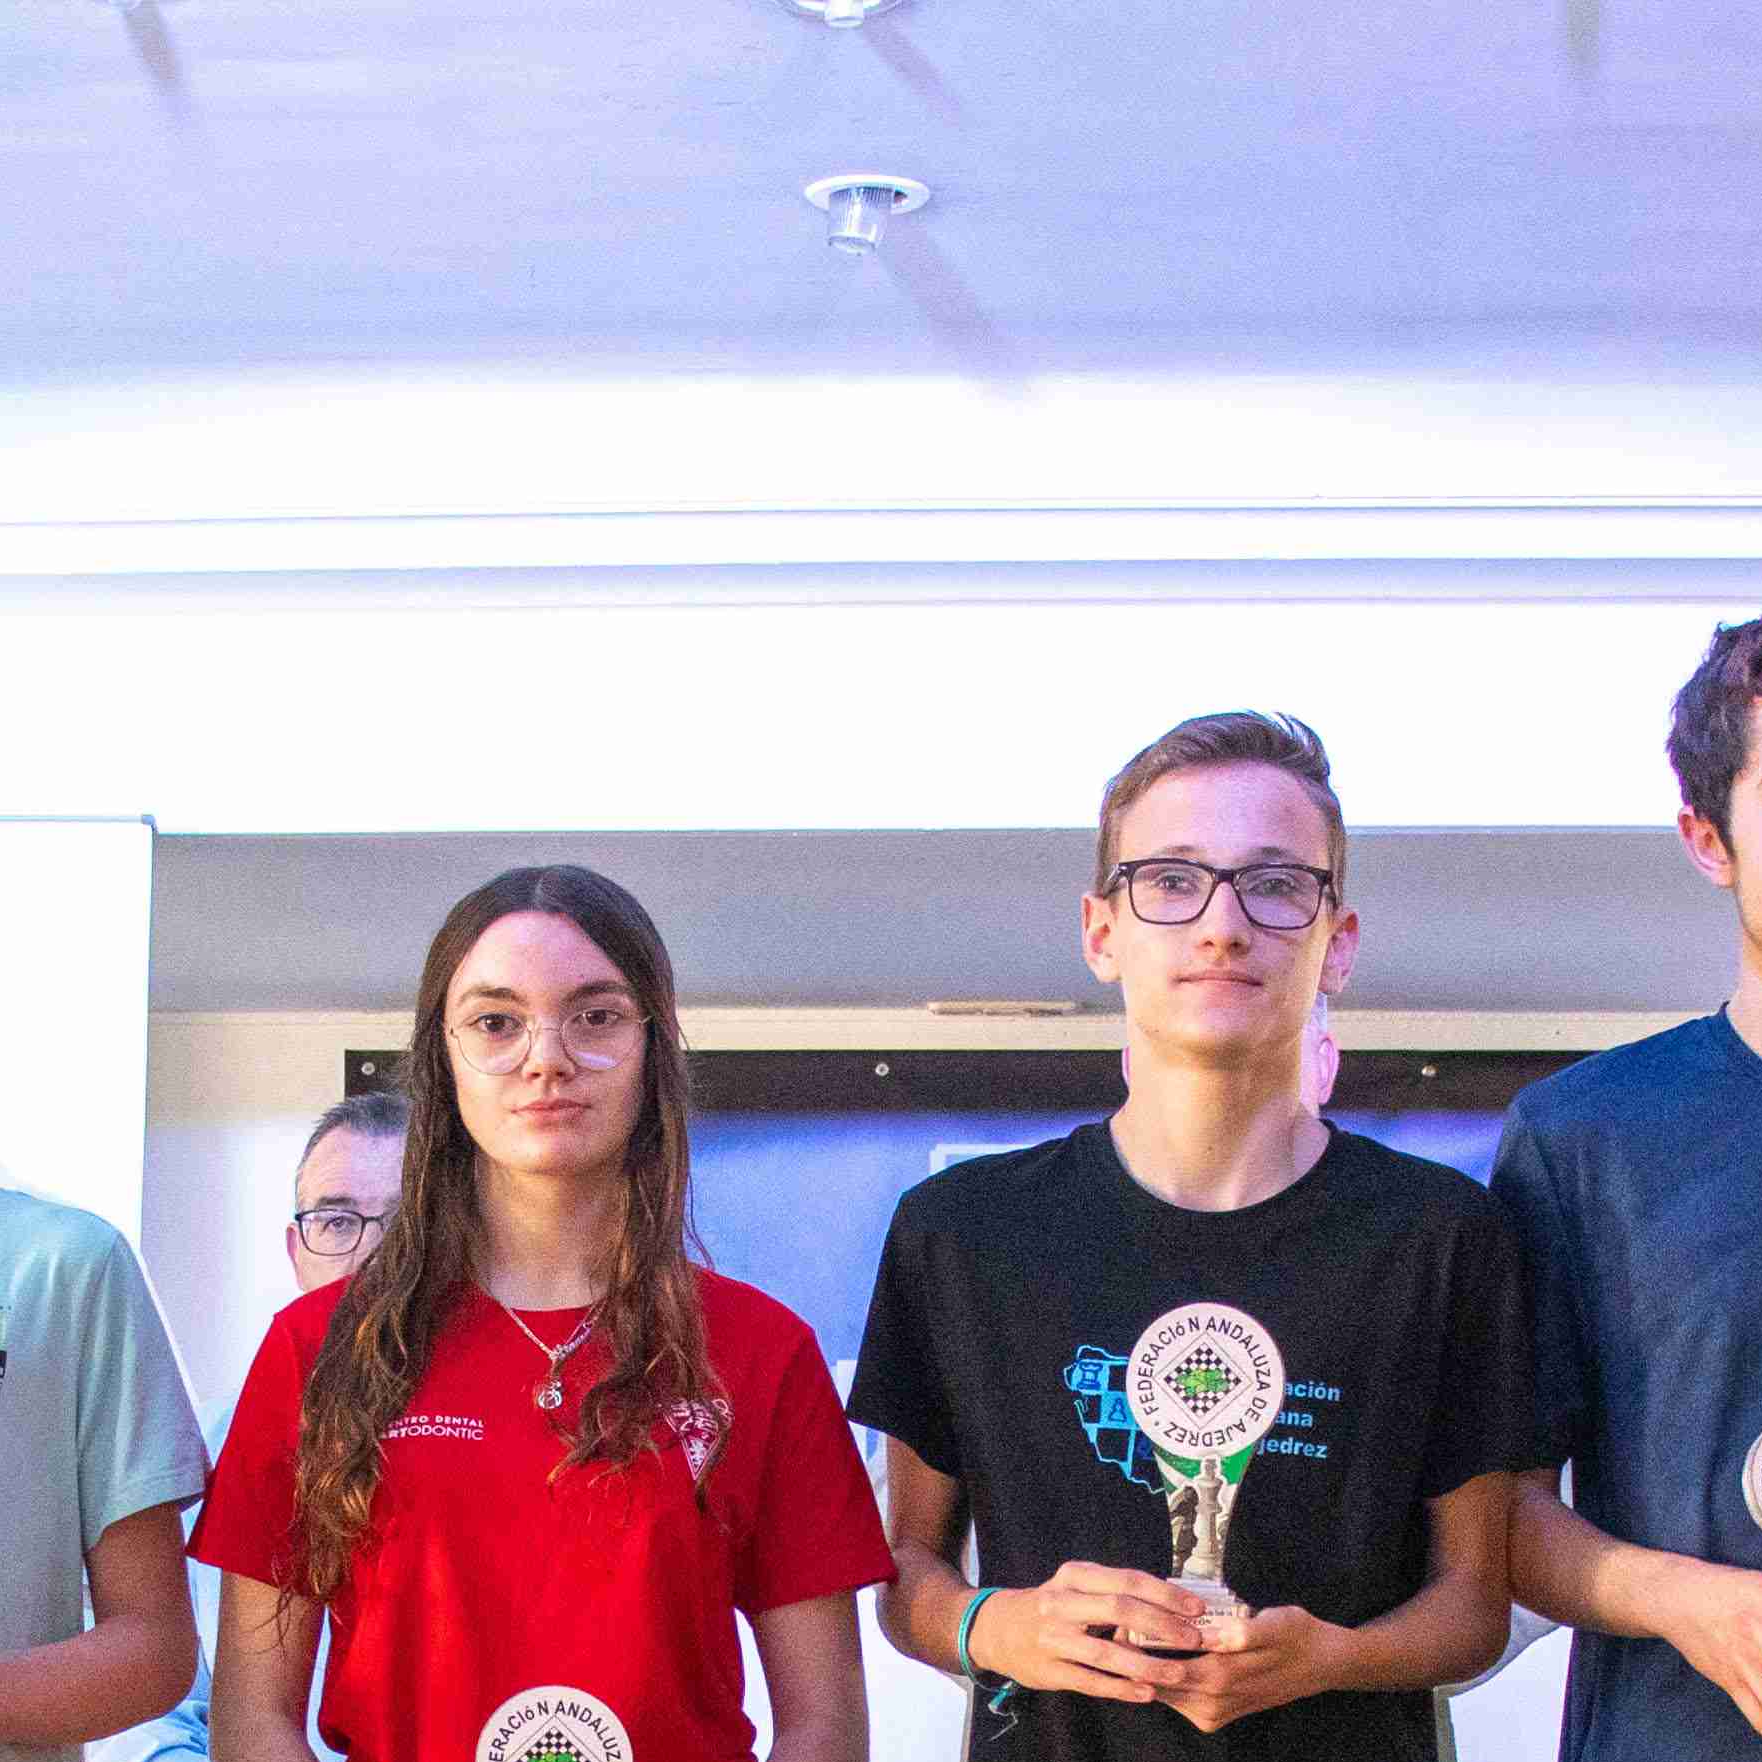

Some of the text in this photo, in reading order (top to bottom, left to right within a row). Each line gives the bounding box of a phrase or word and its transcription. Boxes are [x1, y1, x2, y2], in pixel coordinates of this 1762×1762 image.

[1206, 1316, 1272, 1392] ANDALUZA
[434, 1415, 484, 1428] DENTAL
[1245, 1399, 1268, 1423] DE
[1162, 1421, 1247, 1448] AJEDREZ
